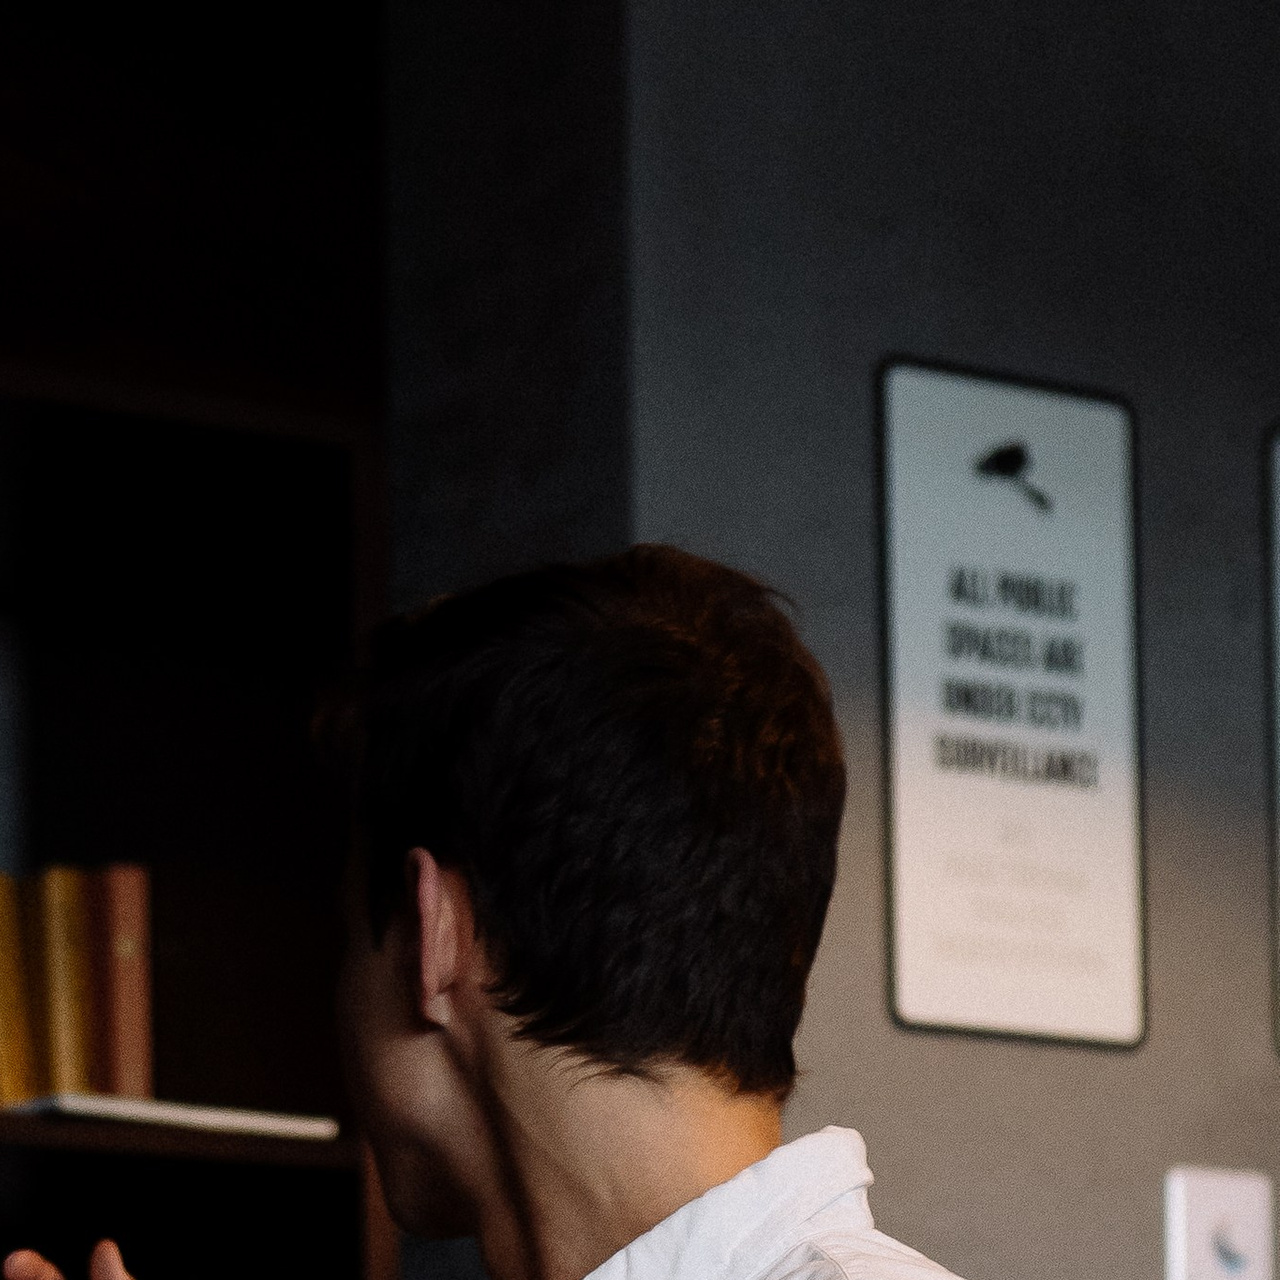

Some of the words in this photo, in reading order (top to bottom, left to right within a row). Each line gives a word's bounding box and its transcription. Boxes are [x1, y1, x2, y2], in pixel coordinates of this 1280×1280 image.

[996, 571, 1077, 621] PUBLIC
[943, 677, 1017, 721] UNDER
[1026, 688, 1083, 731] CCTV
